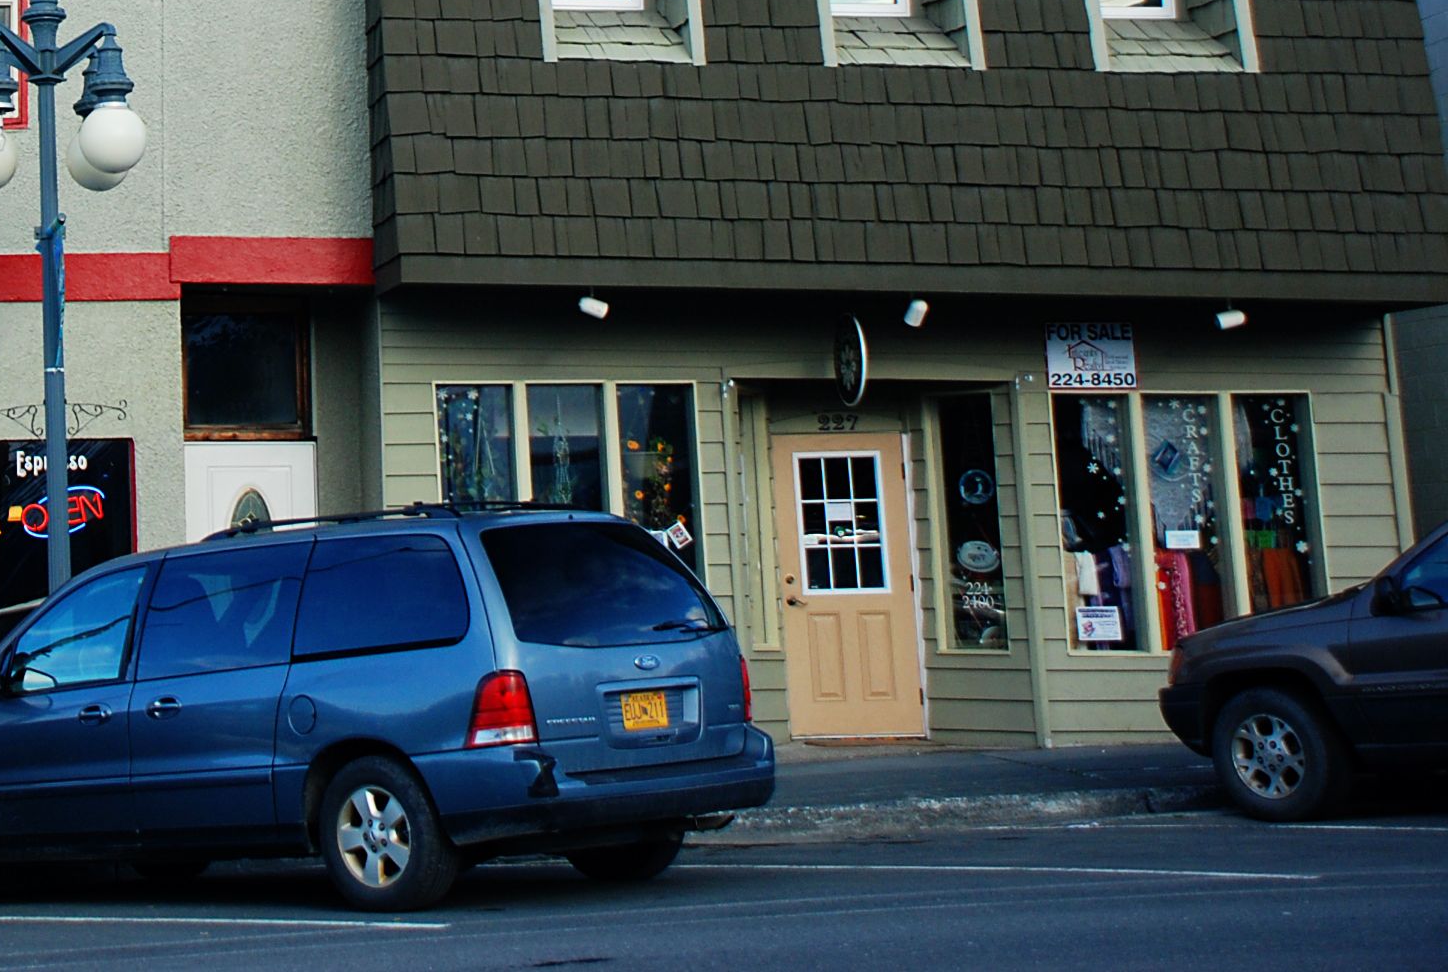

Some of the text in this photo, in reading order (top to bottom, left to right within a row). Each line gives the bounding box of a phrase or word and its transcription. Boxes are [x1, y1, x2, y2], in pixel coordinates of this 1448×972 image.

[1047, 323, 1132, 341] FOR SALE
[1051, 373, 1135, 386] 224-8450
[817, 414, 858, 431] 227
[1182, 408, 1202, 503] CRAFTS
[1270, 409, 1295, 524] CLOTHES
[21, 492, 105, 532] OEN
